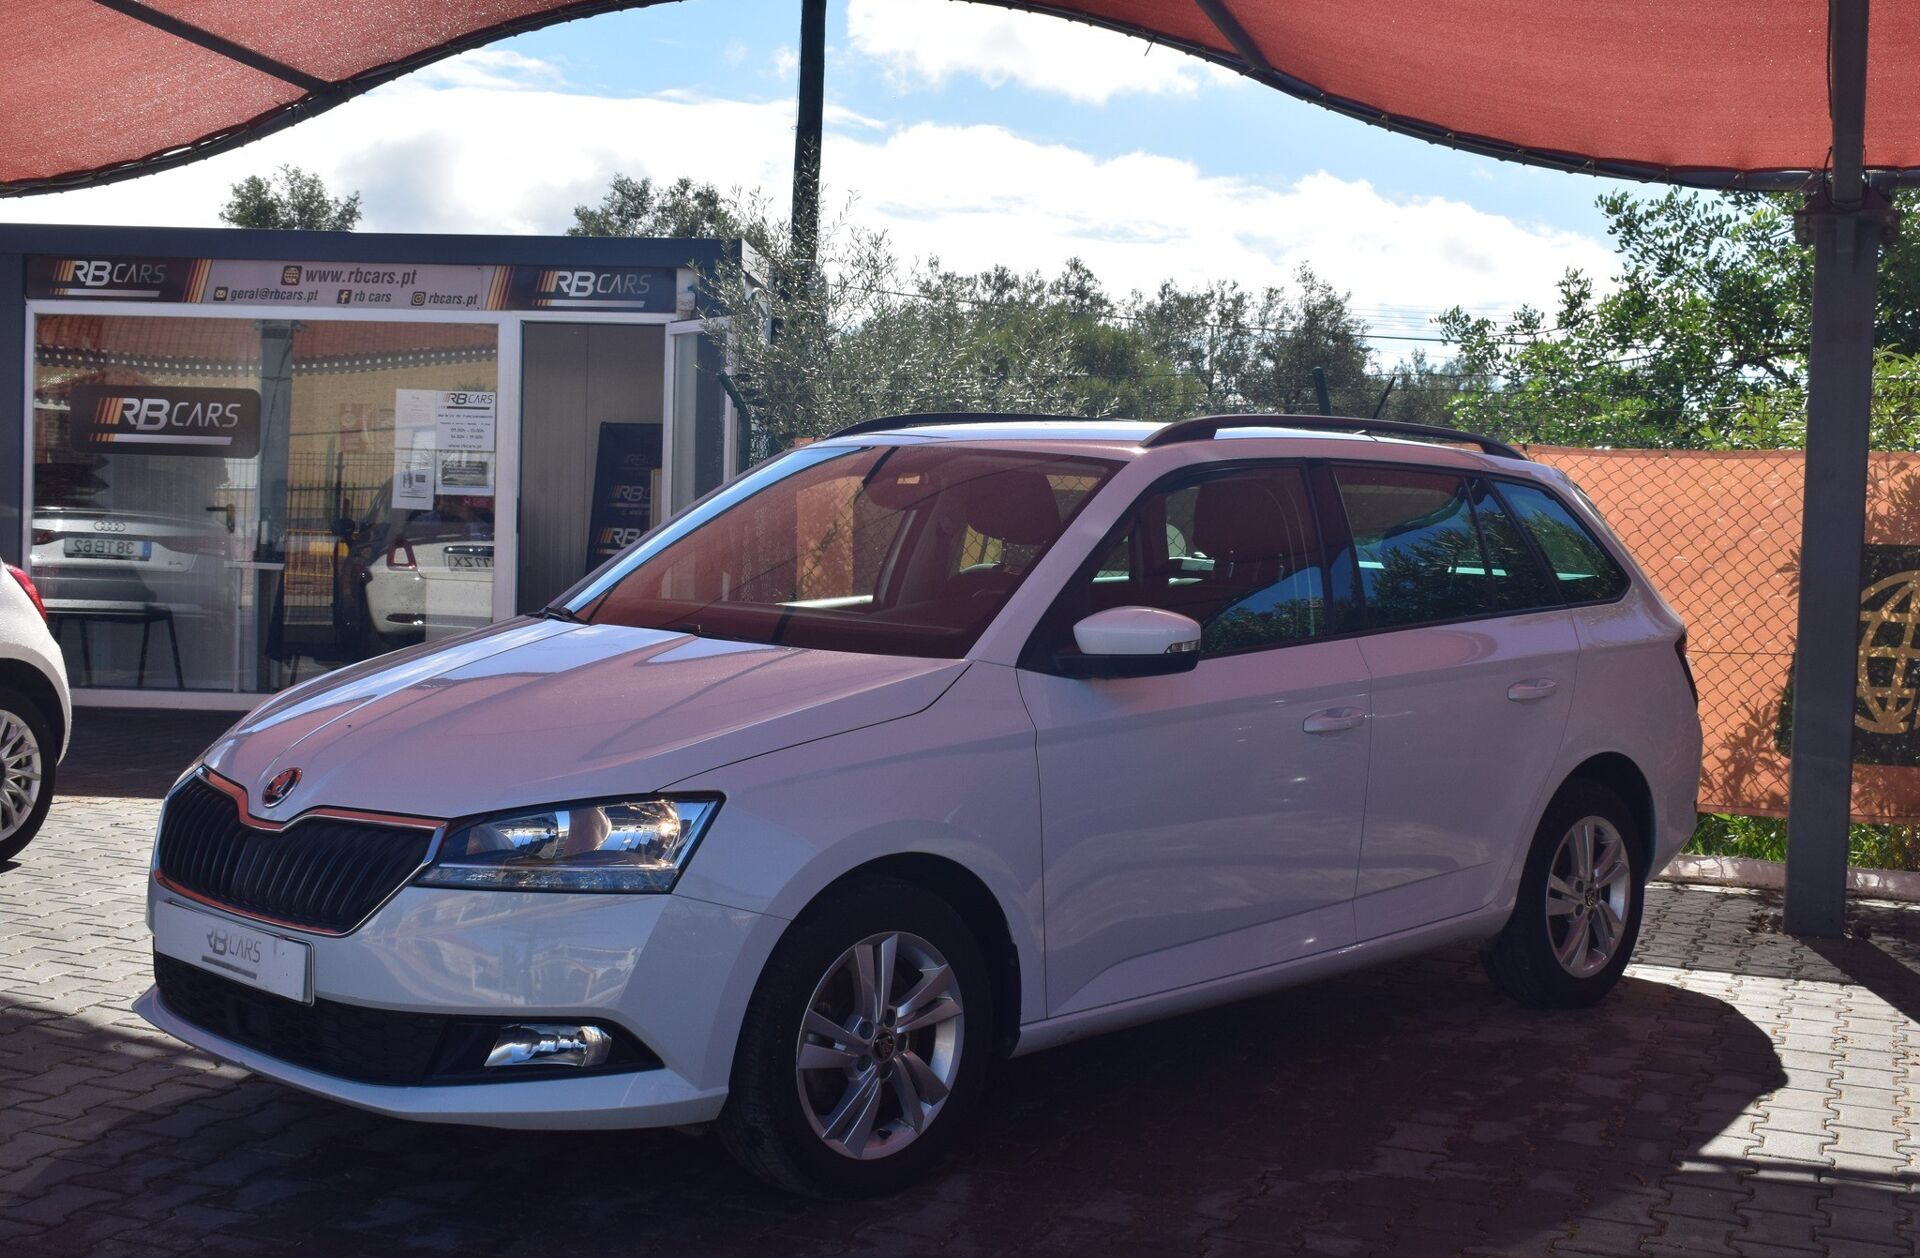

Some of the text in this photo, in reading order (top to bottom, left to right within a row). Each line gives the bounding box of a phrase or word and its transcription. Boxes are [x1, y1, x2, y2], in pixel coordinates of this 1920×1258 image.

[305, 267, 417, 288] www.rbcars.pt
[230, 287, 318, 303] geral@rbcars.pt
[354, 289, 392, 303] rb cars
[428, 292, 478, 307] rbcars.pt
